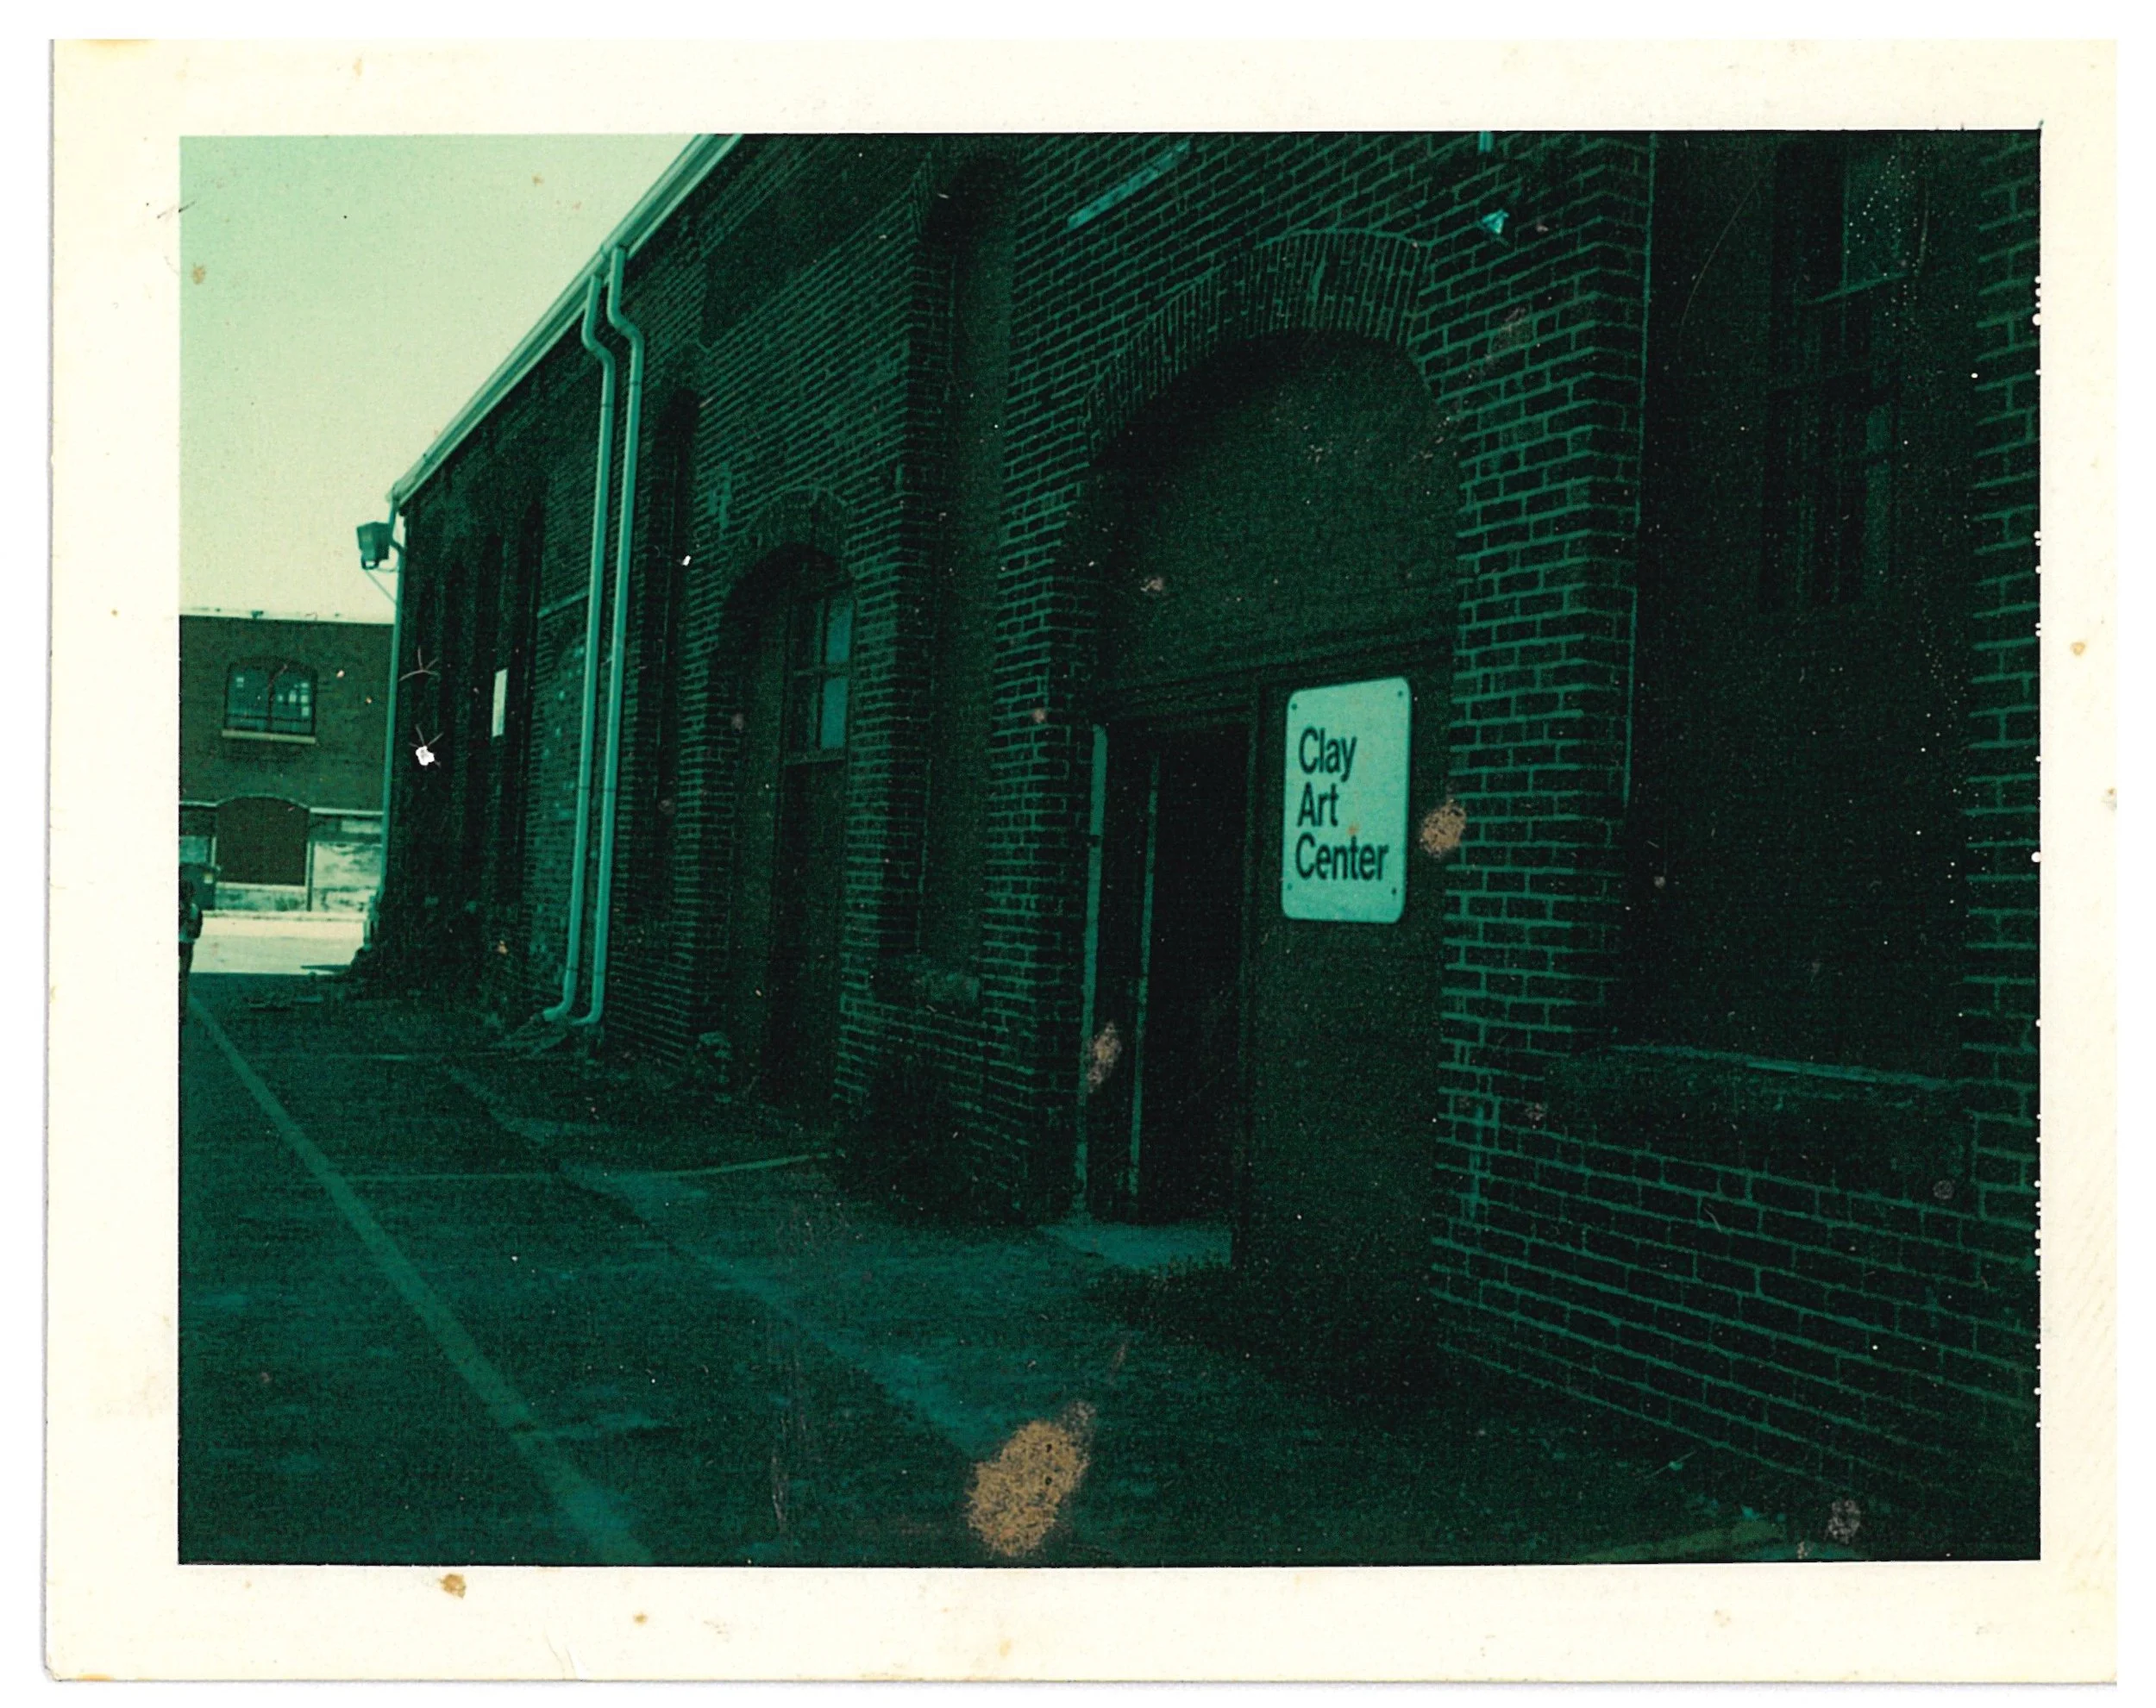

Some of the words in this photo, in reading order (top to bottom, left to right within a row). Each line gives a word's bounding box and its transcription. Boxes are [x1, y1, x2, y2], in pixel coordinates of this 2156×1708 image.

[1299, 726, 1357, 783] Clay
[1297, 781, 1339, 827] Art
[1295, 832, 1389, 880] Center
